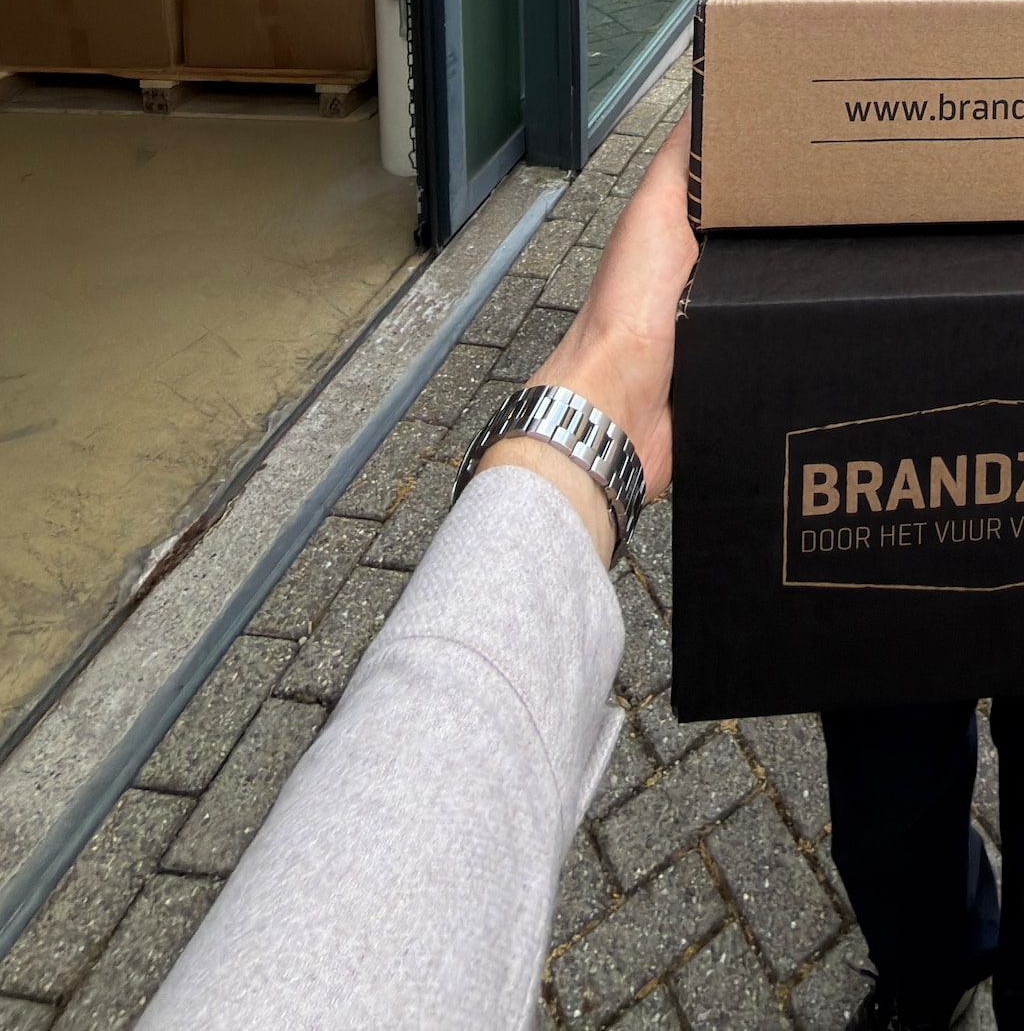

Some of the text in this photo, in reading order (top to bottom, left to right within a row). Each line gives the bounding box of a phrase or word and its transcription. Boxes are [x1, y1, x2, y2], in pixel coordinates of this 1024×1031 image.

[802, 526, 871, 553] DOOR
[880, 522, 927, 547] HET
[935, 517, 1001, 543] VUUR
